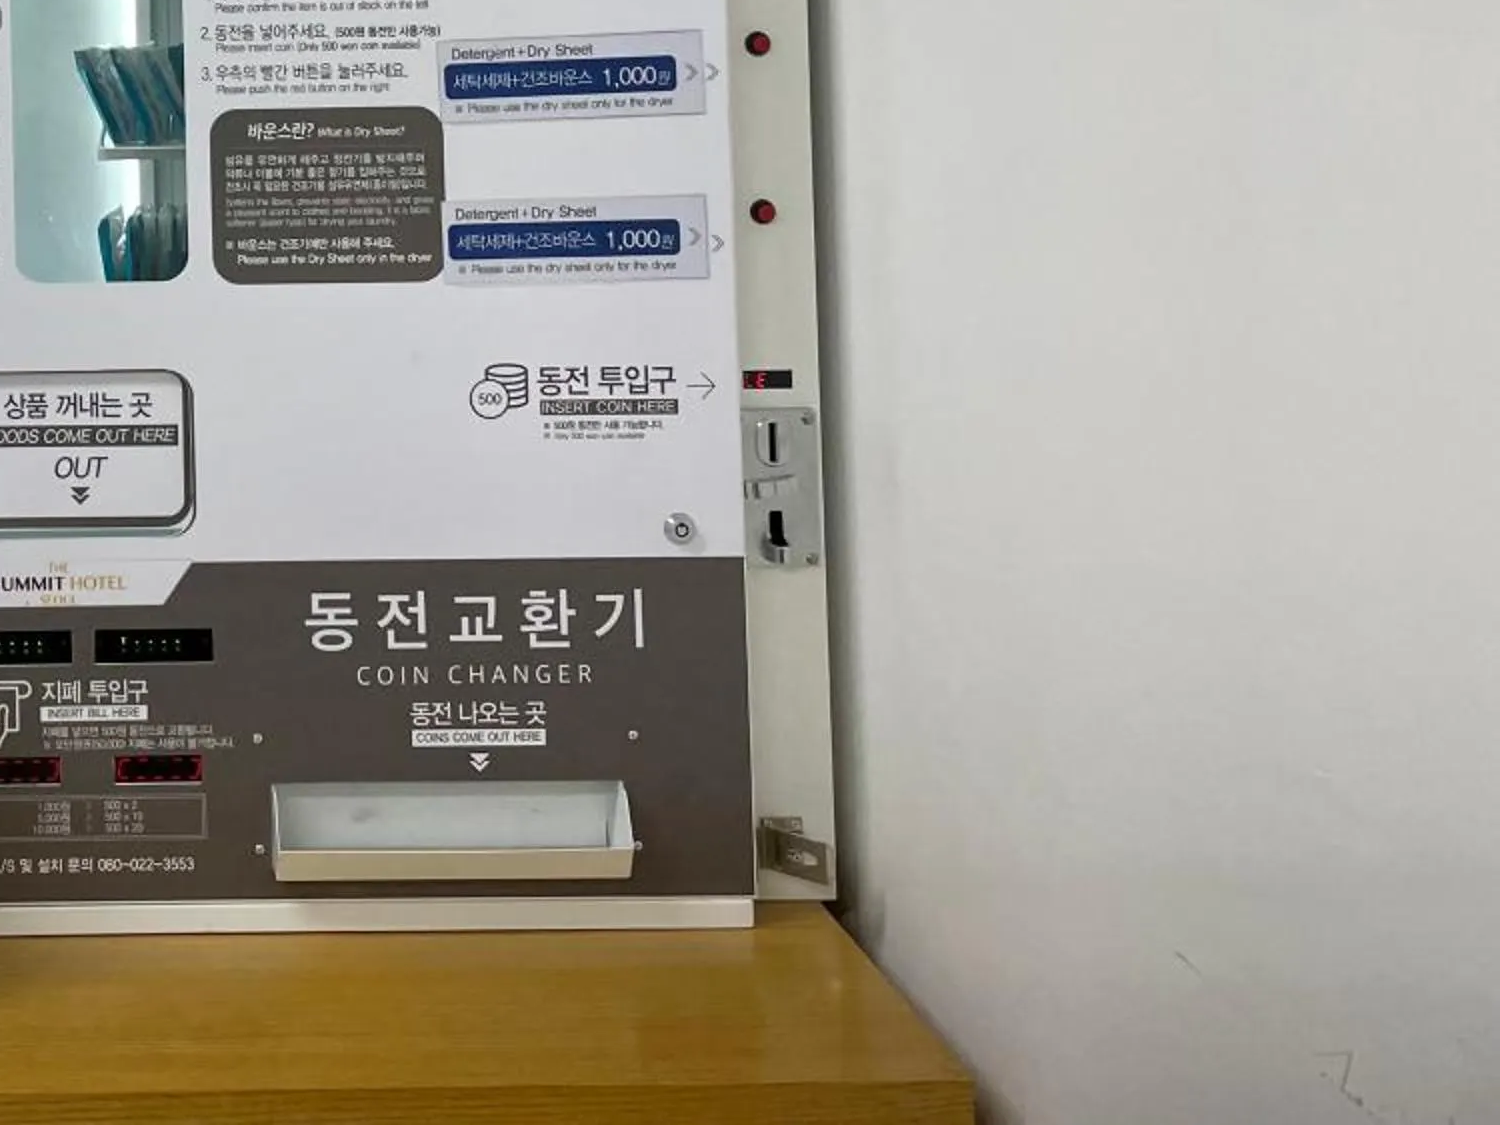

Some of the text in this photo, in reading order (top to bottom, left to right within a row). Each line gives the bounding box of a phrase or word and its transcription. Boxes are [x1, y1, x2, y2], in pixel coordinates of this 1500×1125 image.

[215, 24, 254, 41] 동전을
[556, 44, 593, 55] Sheet
[260, 64, 288, 81] 빨간
[292, 63, 331, 80] 버튼을
[602, 67, 671, 89] 1,000원
[247, 122, 315, 141] 바운스란?
[560, 205, 596, 217] Sheet
[607, 229, 676, 251] 1,000원
[537, 365, 676, 395] 동전 투입구
[4, 392, 153, 419] 상품 꺼내는 곳
[478, 392, 502, 406] 500
[541, 400, 676, 414] INSERT COIN HERE
[43, 428, 92, 443] COME
[95, 428, 129, 442] OUT
[133, 427, 176, 442] HERE
[54, 456, 108, 479] OUT
[50, 562, 68, 573] THE
[70, 575, 128, 590] HOTEL
[304, 588, 645, 652] 동전교환기
[357, 664, 593, 686] COIN CHANGER
[42, 680, 148, 703] 지폐 투입구
[48, 707, 140, 718] INSERT BILL HERE
[410, 700, 547, 726] 동전 나오는 곳
[416, 730, 541, 744] COINS COME OUT HERE
[38, 858, 63, 873] 설치
[68, 857, 93, 872] 문의
